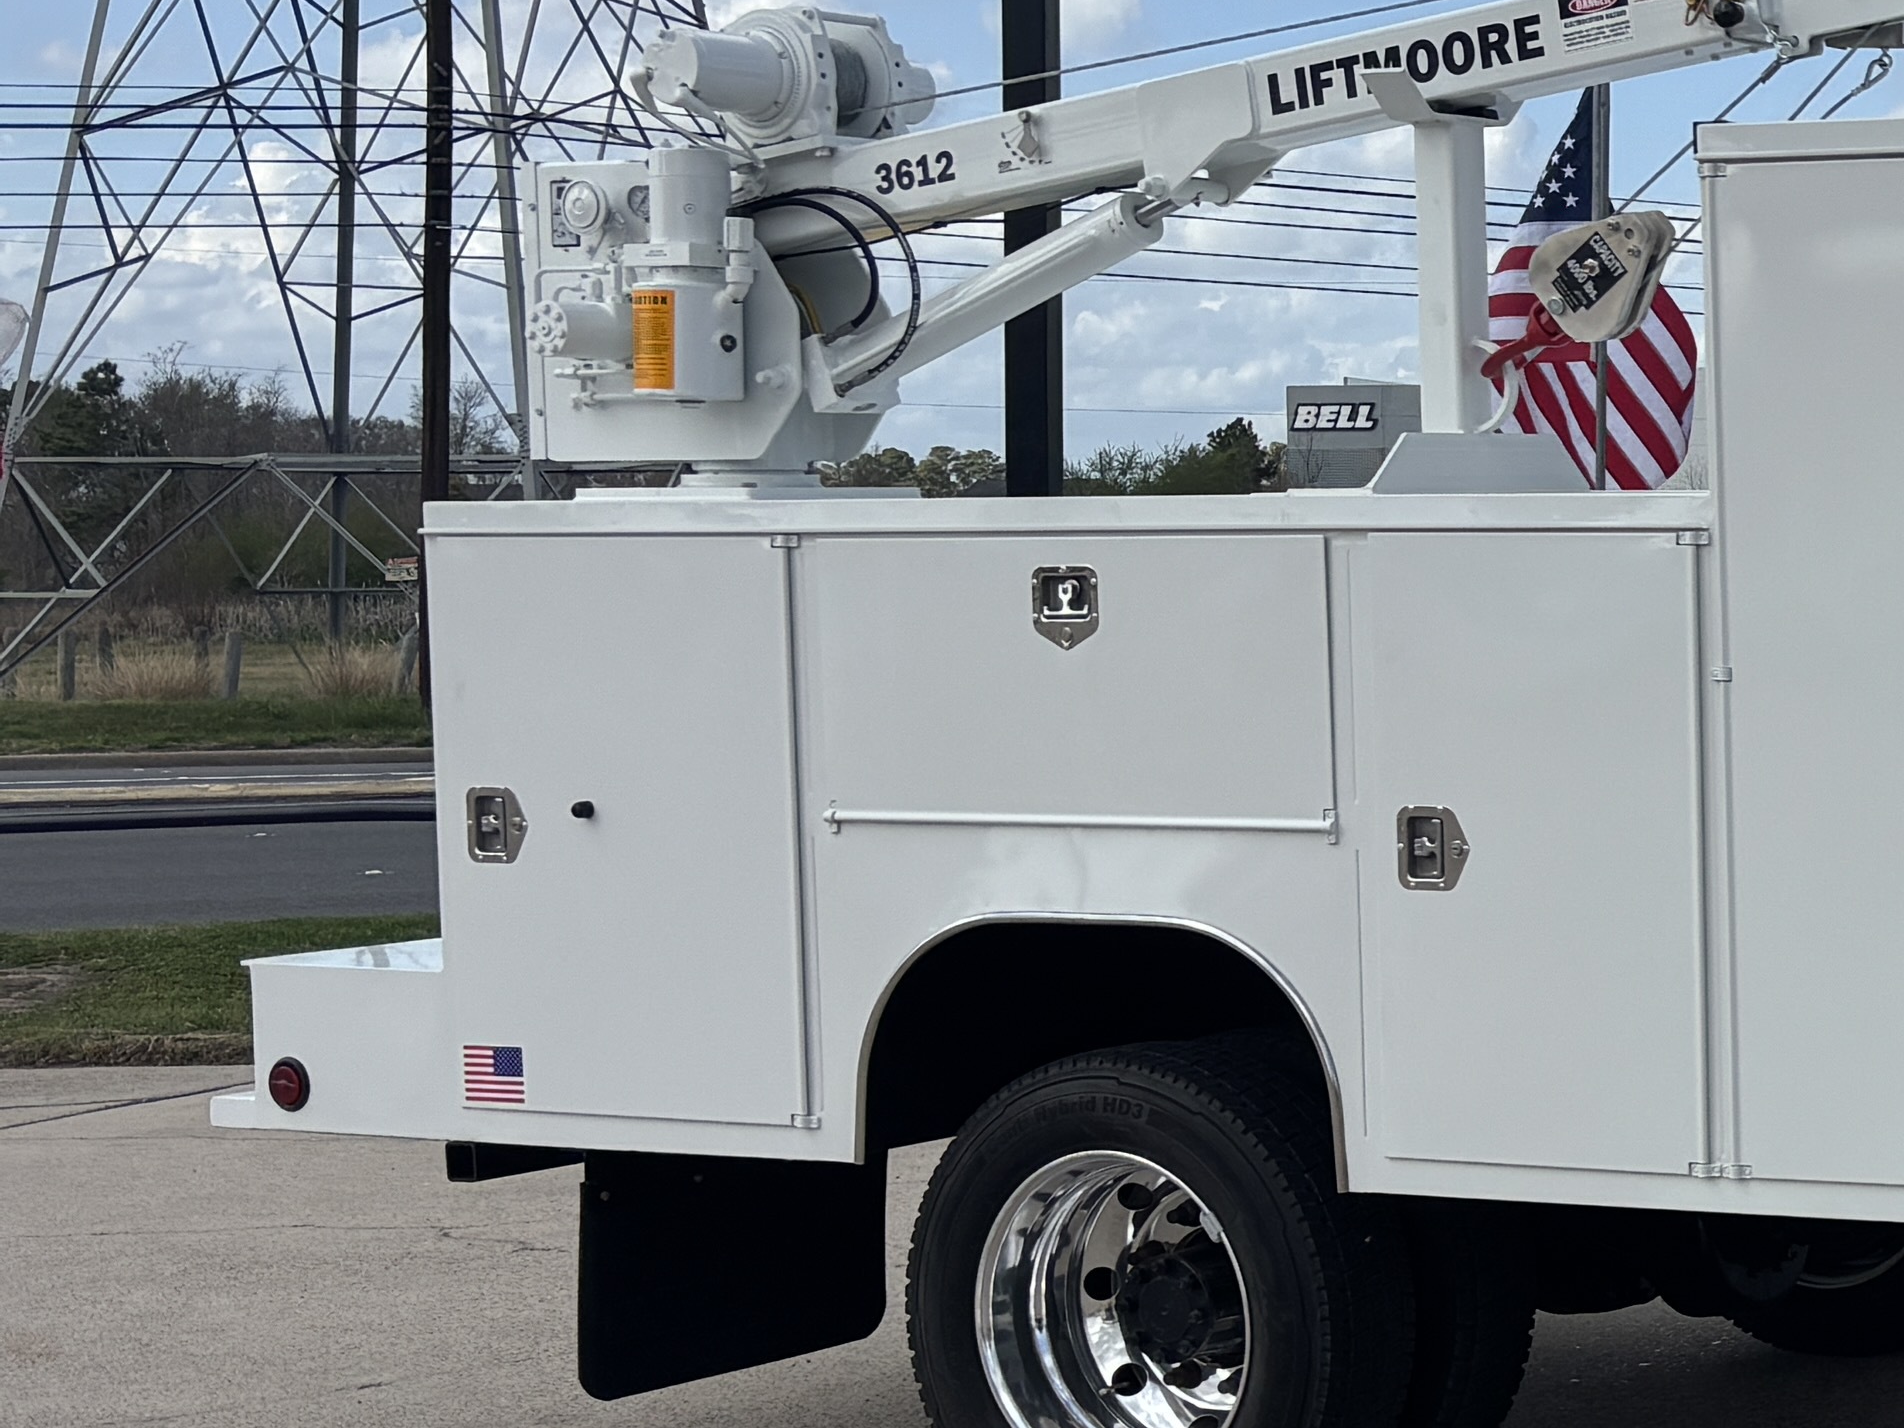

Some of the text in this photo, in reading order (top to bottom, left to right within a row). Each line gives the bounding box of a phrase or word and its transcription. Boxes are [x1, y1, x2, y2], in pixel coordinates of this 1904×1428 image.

[874, 150, 956, 195] 3612
[1589, 234, 1625, 277] CAPACITY
[1293, 404, 1375, 429] BELL
[1102, 1096, 1145, 1120] HD3
